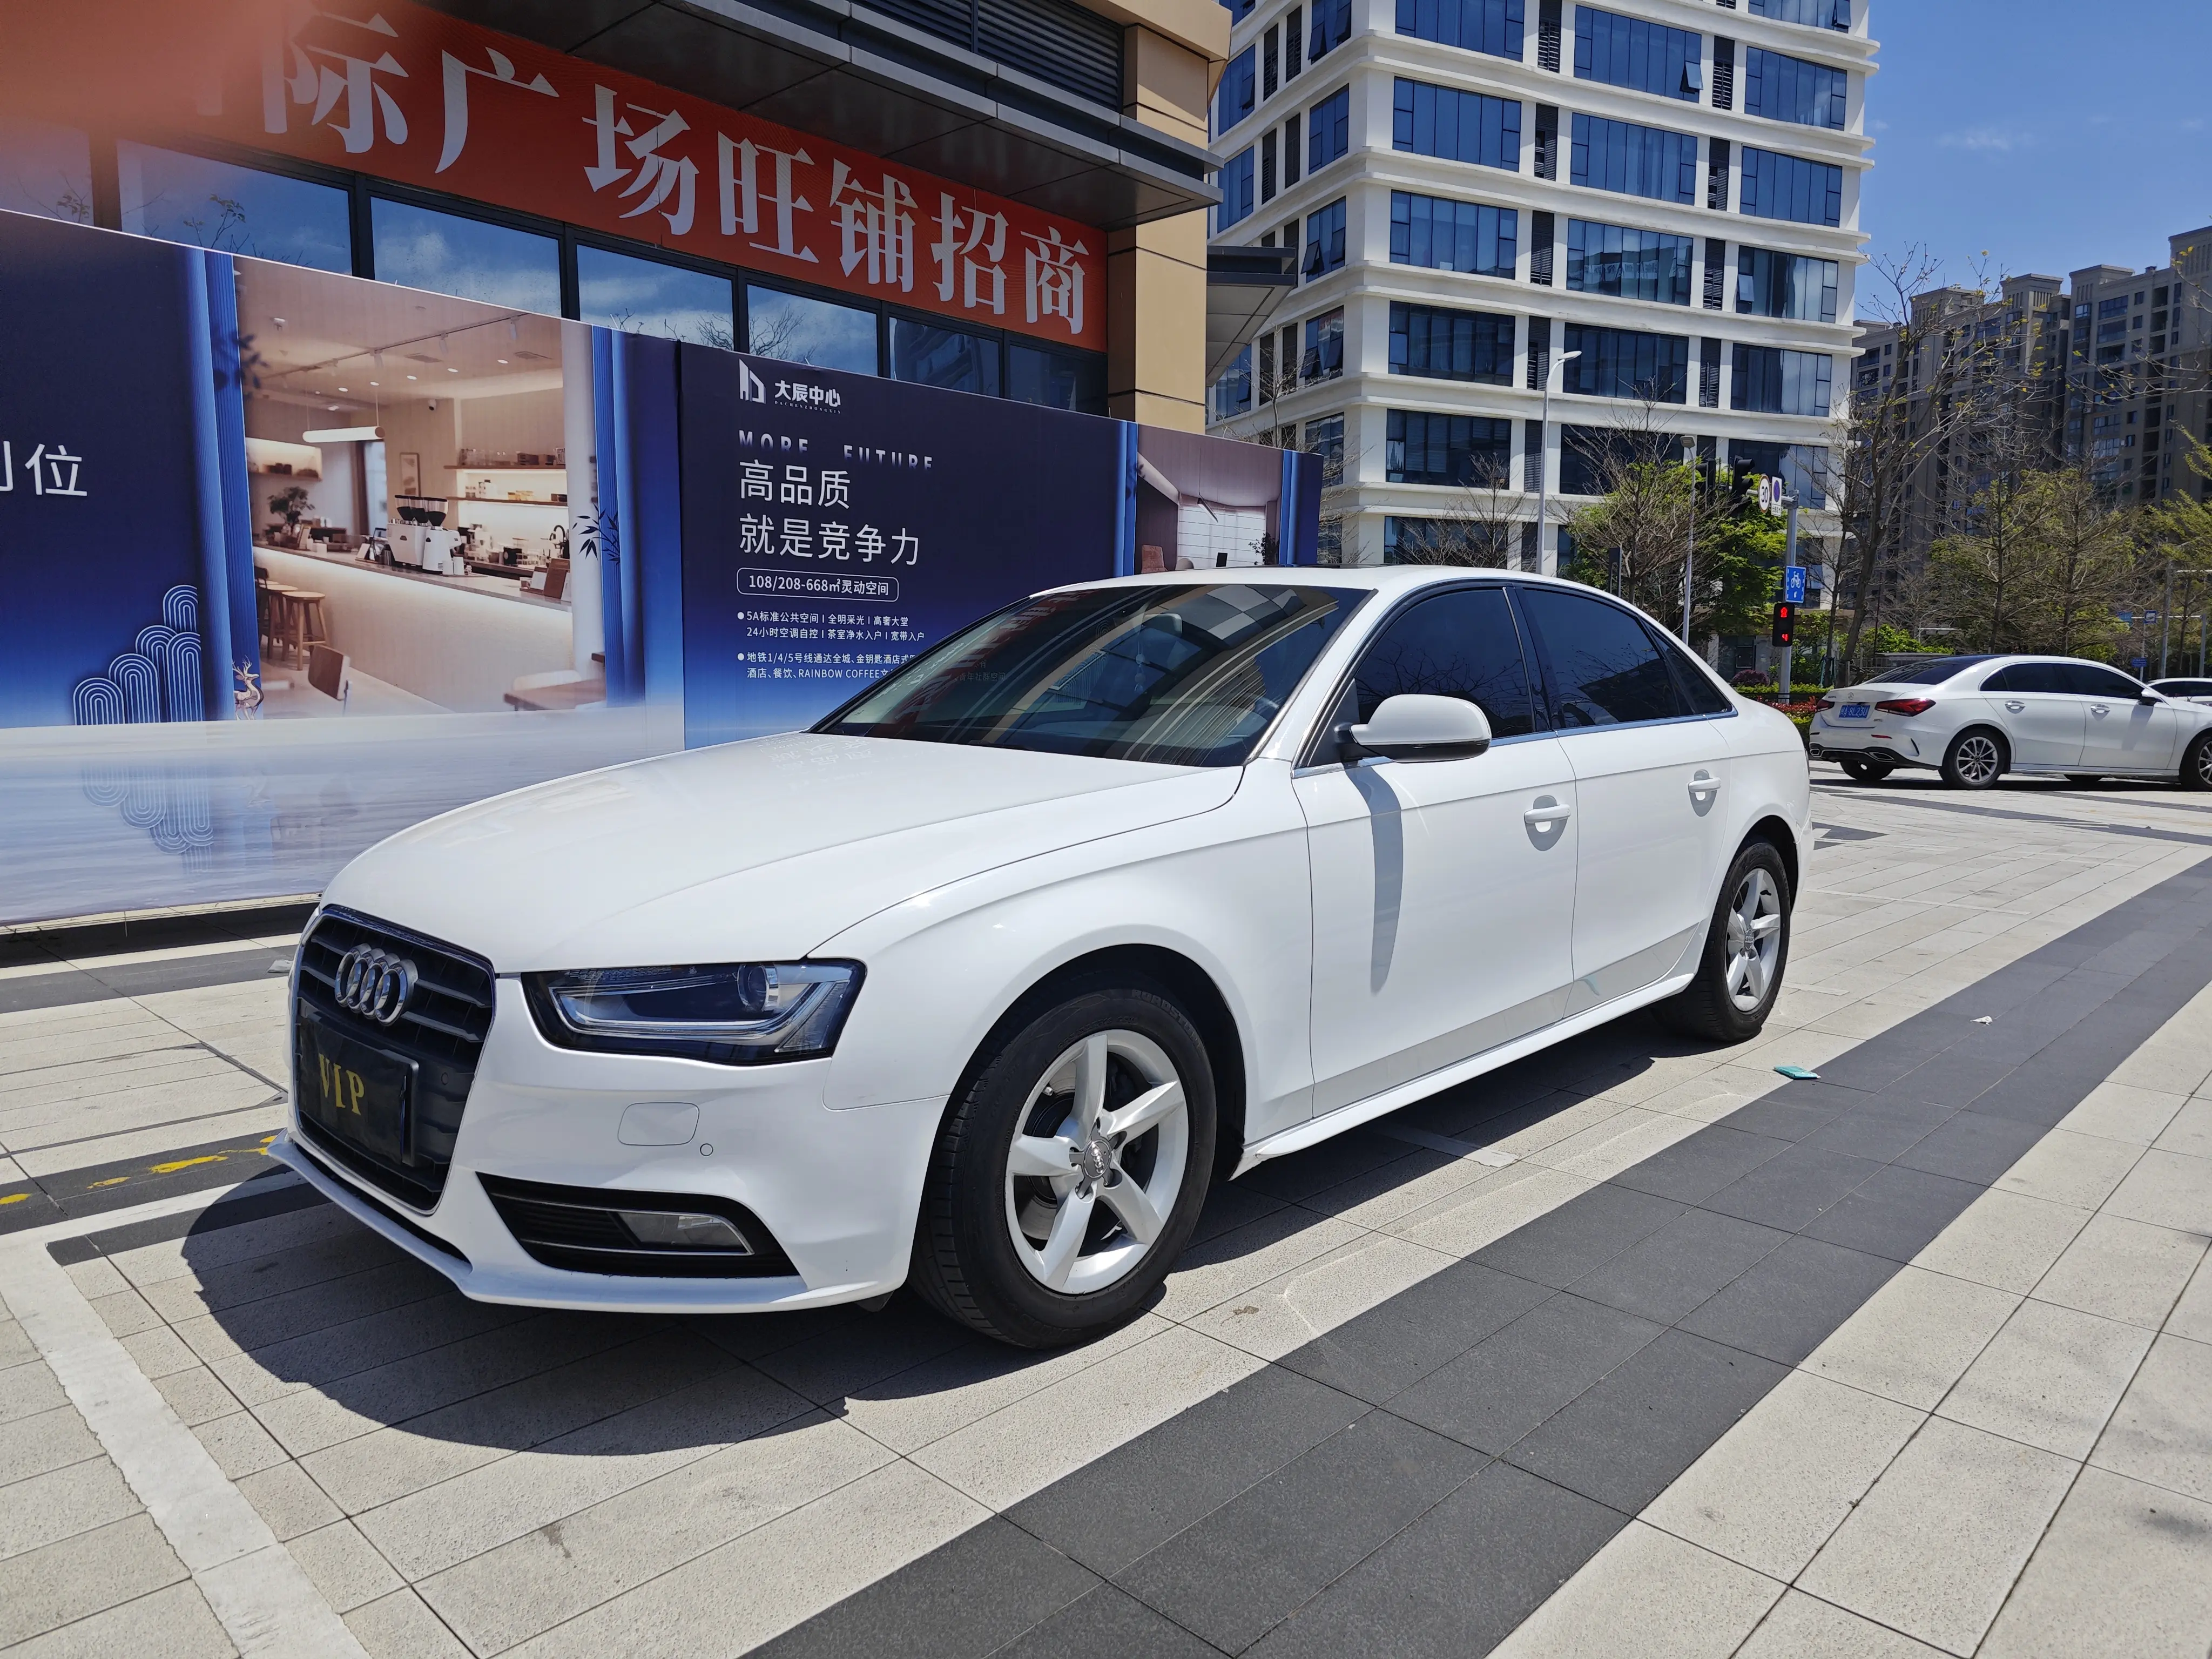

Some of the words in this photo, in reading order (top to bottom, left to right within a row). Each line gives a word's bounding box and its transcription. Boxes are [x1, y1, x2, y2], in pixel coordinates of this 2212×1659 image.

[774, 380, 841, 407] 大辰中心
[774, 400, 841, 414] DACHENZHONGXIN
[739, 459, 851, 509] 高品质
[1761, 486, 1768, 503] 30
[739, 513, 919, 565] 就是竞争力
[846, 668, 893, 679] COFFEE文
[318, 1054, 365, 1116] VIP
